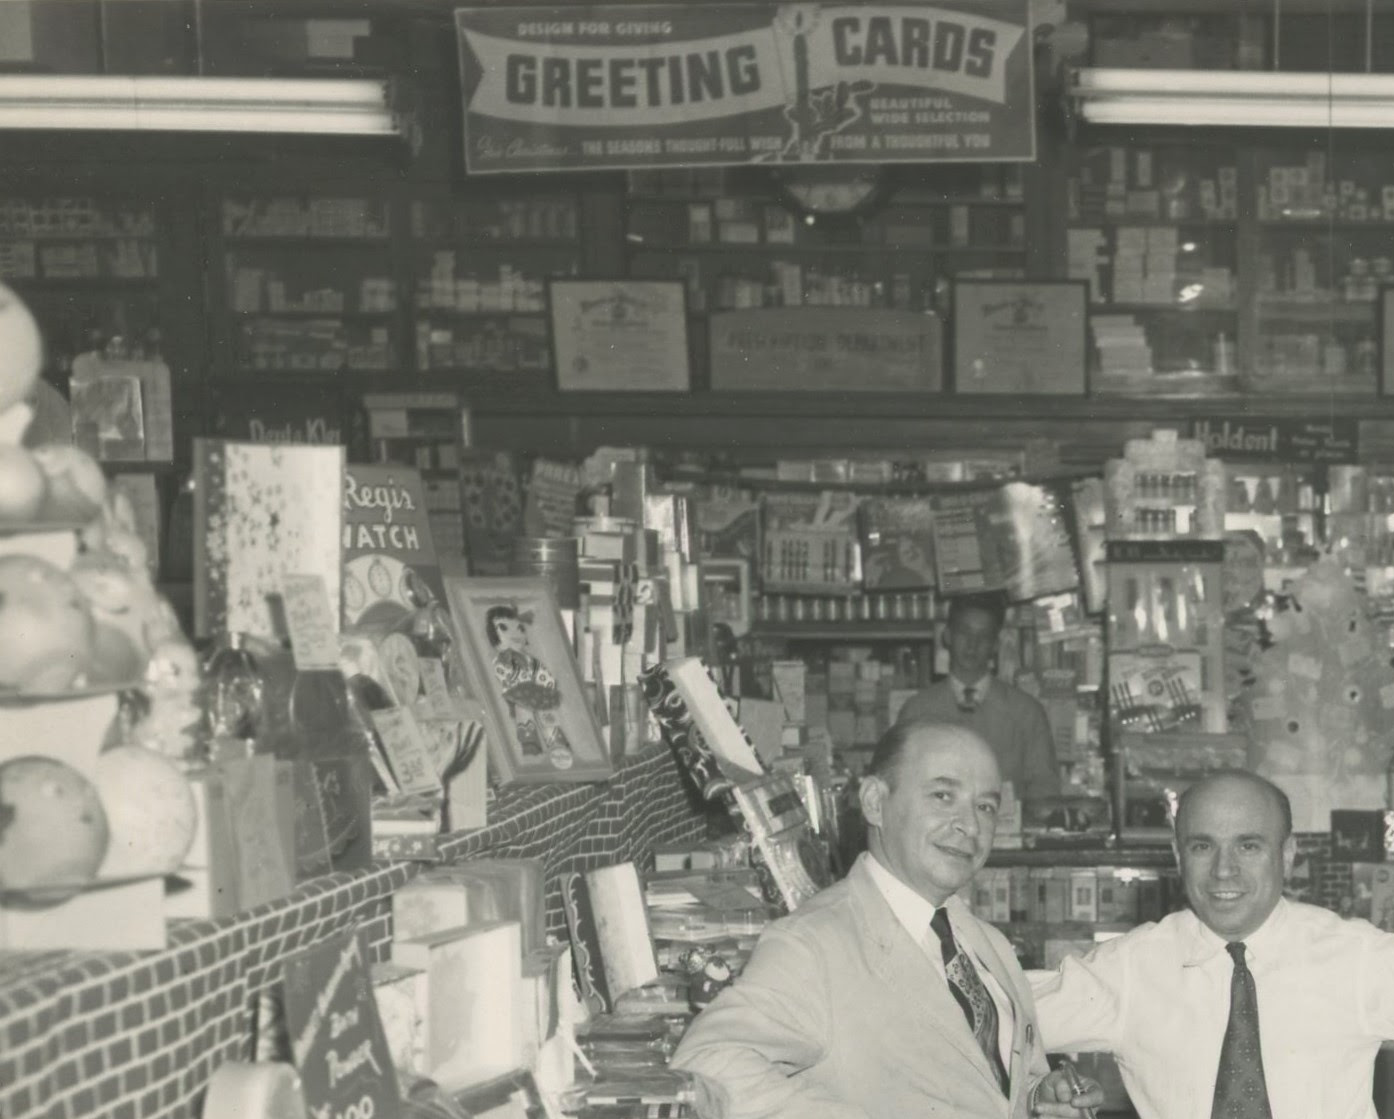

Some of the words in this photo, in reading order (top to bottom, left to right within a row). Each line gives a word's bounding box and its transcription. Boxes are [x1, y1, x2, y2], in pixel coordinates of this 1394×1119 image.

[518, 22, 574, 36] DESIGN
[579, 21, 610, 35] FOR
[616, 20, 673, 34] GIVING
[506, 44, 761, 109] GREETING
[832, 16, 997, 79] CARDS
[914, 112, 990, 123] SELECTION
